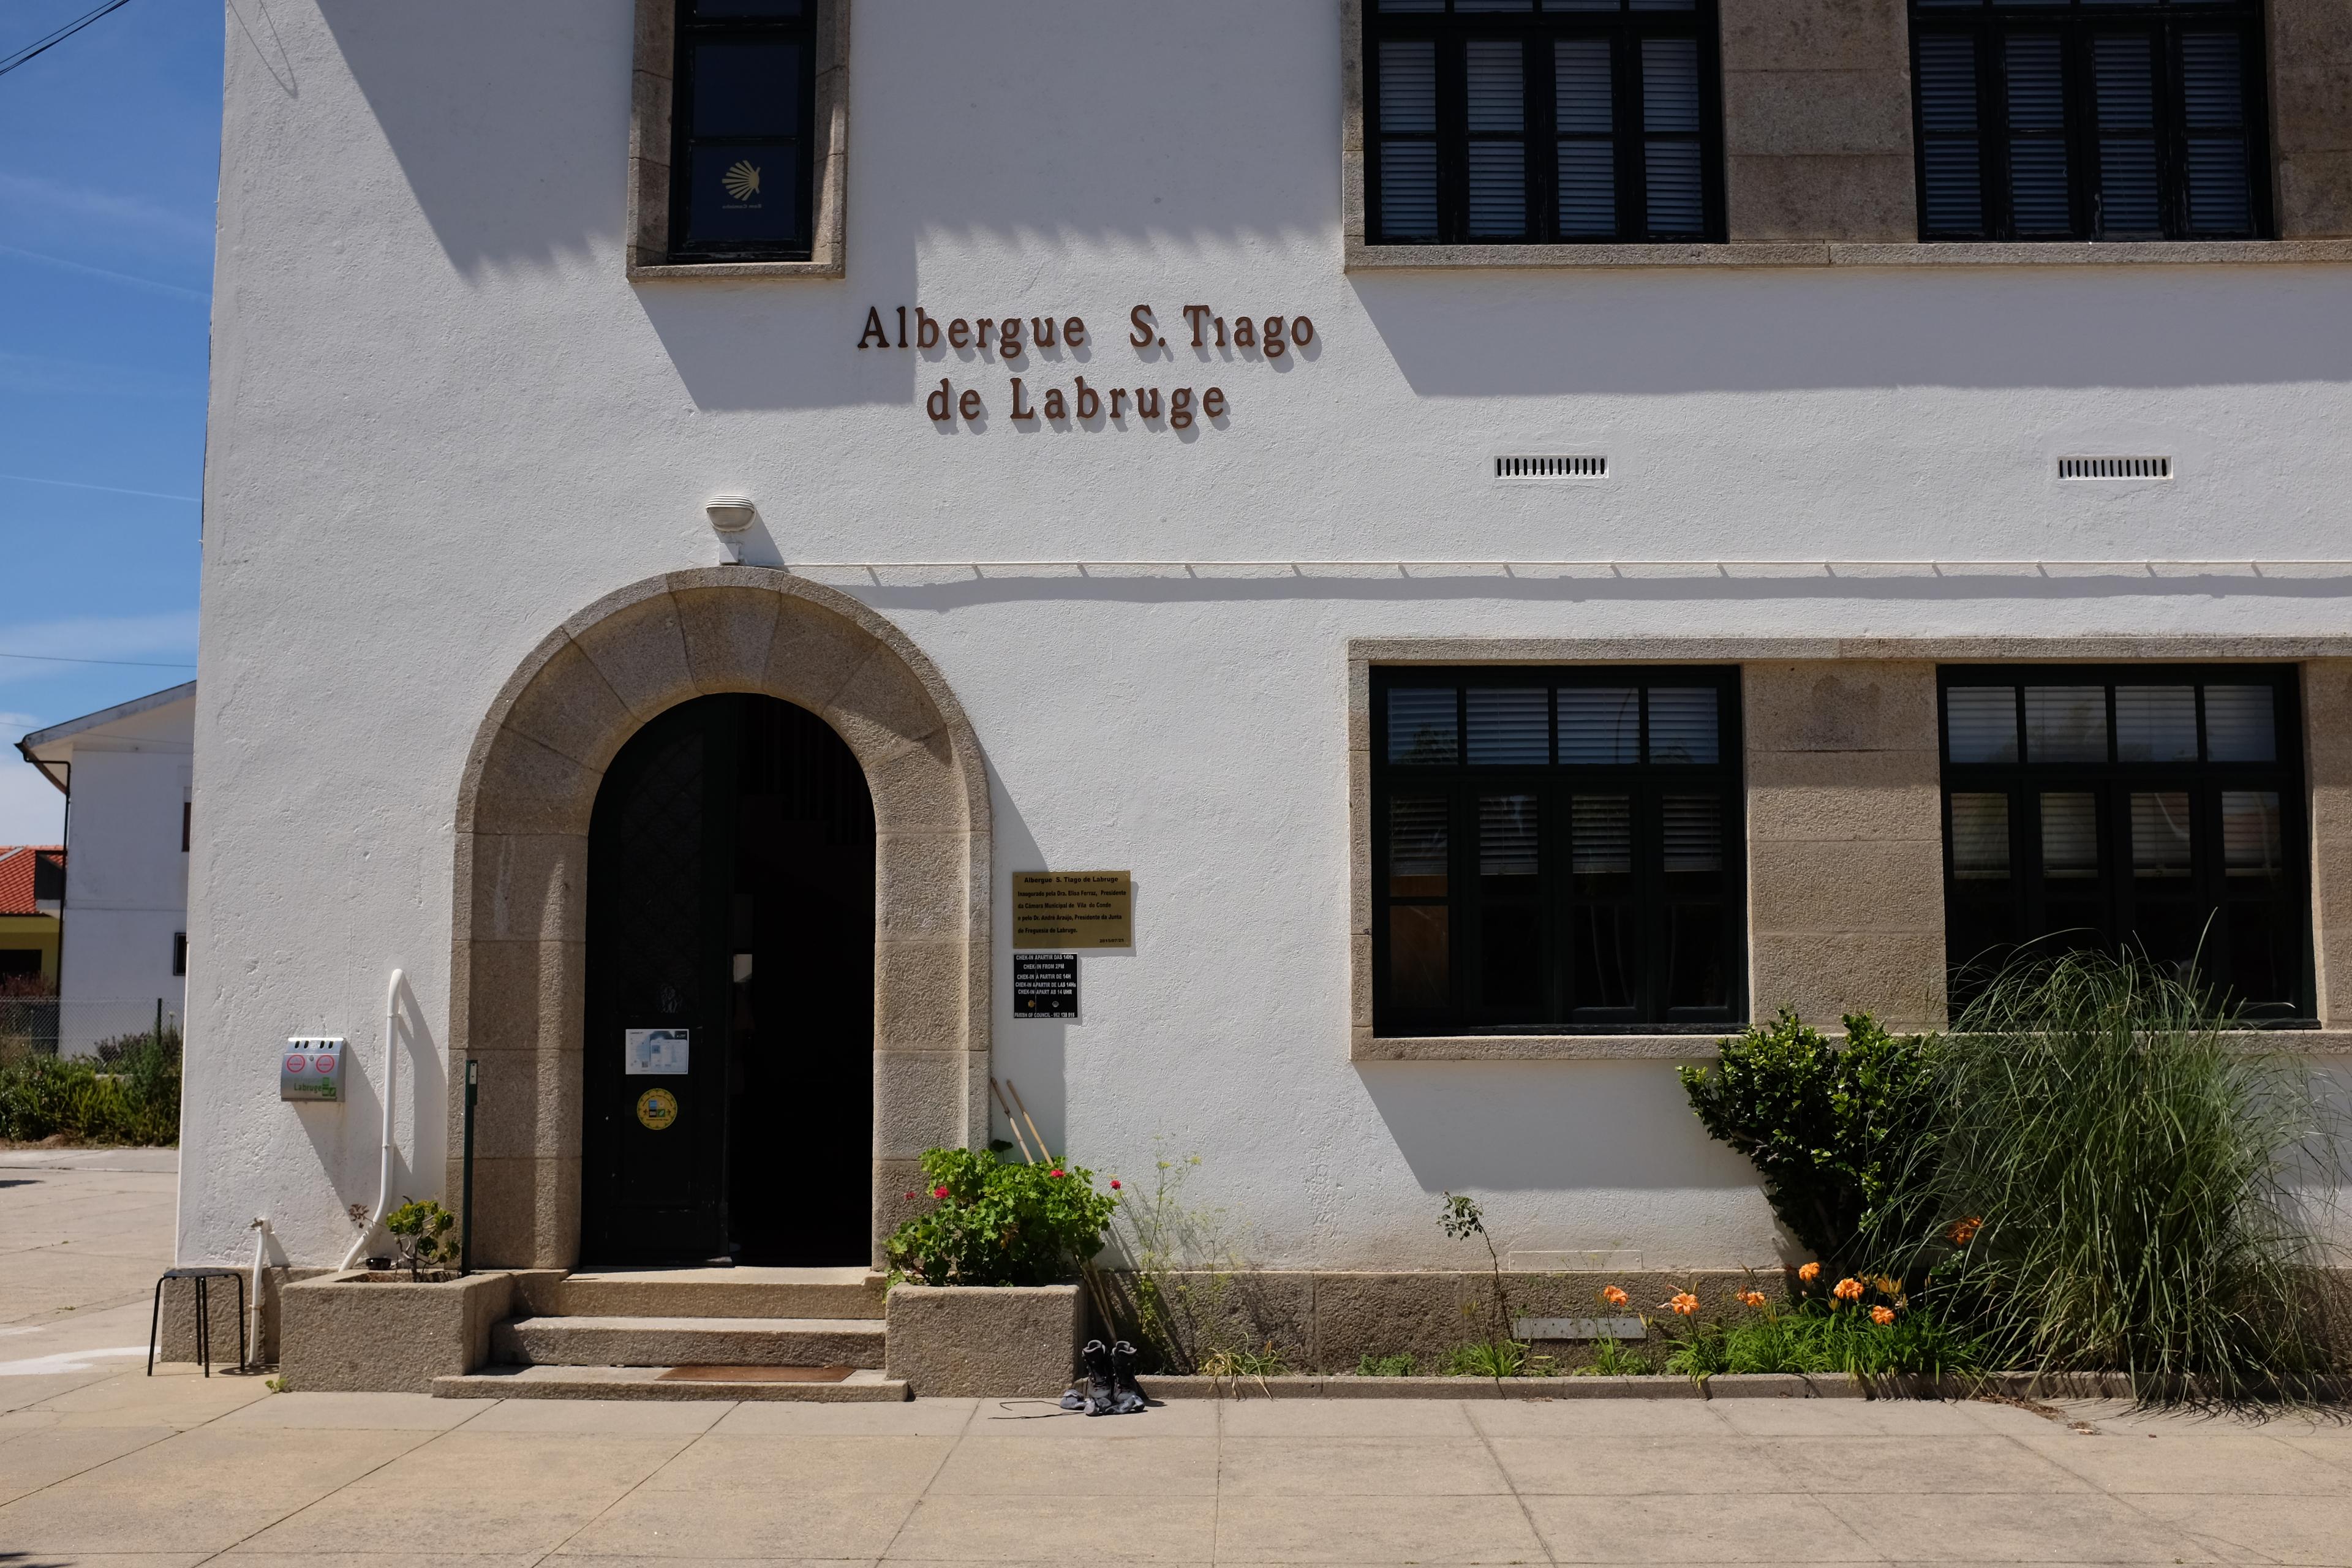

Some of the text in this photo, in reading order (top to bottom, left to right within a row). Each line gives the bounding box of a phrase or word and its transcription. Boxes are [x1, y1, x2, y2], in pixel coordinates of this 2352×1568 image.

[857, 305, 1085, 359] Albergue
[1129, 304, 1167, 348] S.
[927, 376, 1224, 430] de Labruge
[294, 1083, 322, 1093] Labruge
